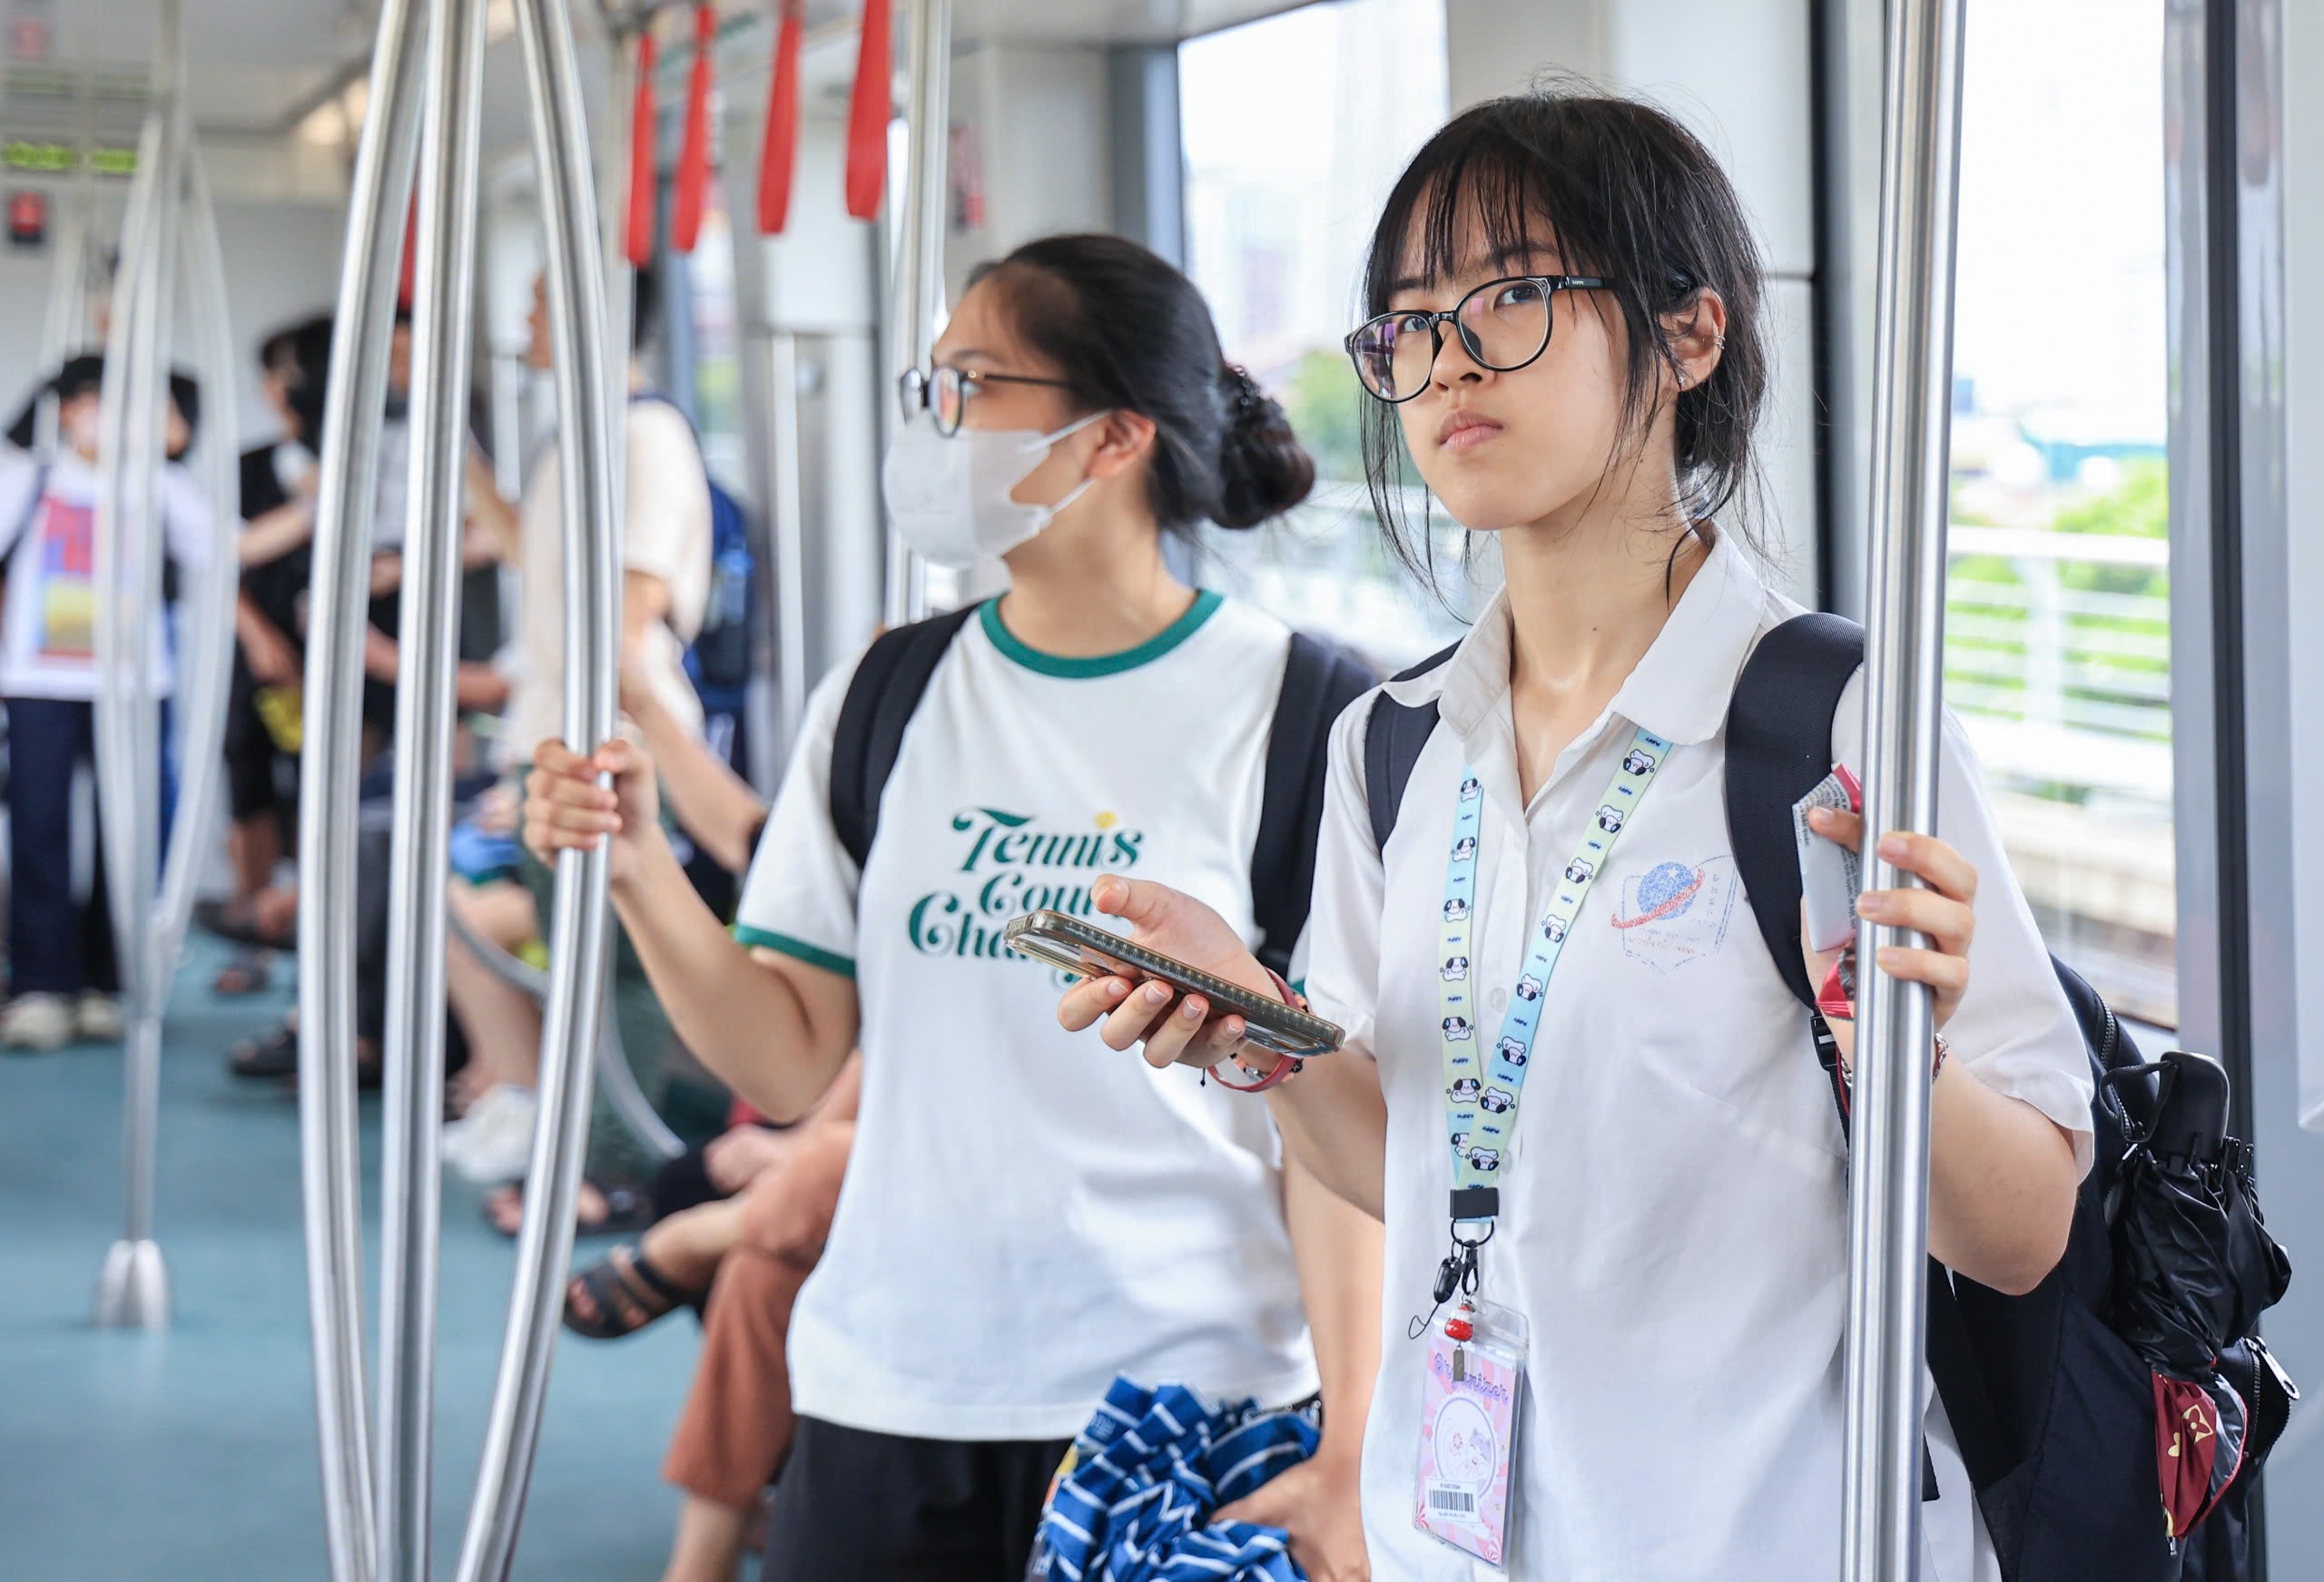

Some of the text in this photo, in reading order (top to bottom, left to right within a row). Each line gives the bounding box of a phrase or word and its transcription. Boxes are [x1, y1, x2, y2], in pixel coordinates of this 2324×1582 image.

[1646, 737, 1660, 747] PUPPY
[1618, 785, 1632, 795] PUPPY
[951, 807, 1144, 871] Tennis
[1588, 840, 1601, 850] PUPPY
[1497, 1073, 1513, 1082] PUPPY
[1482, 1126, 1500, 1135] PUPPY
